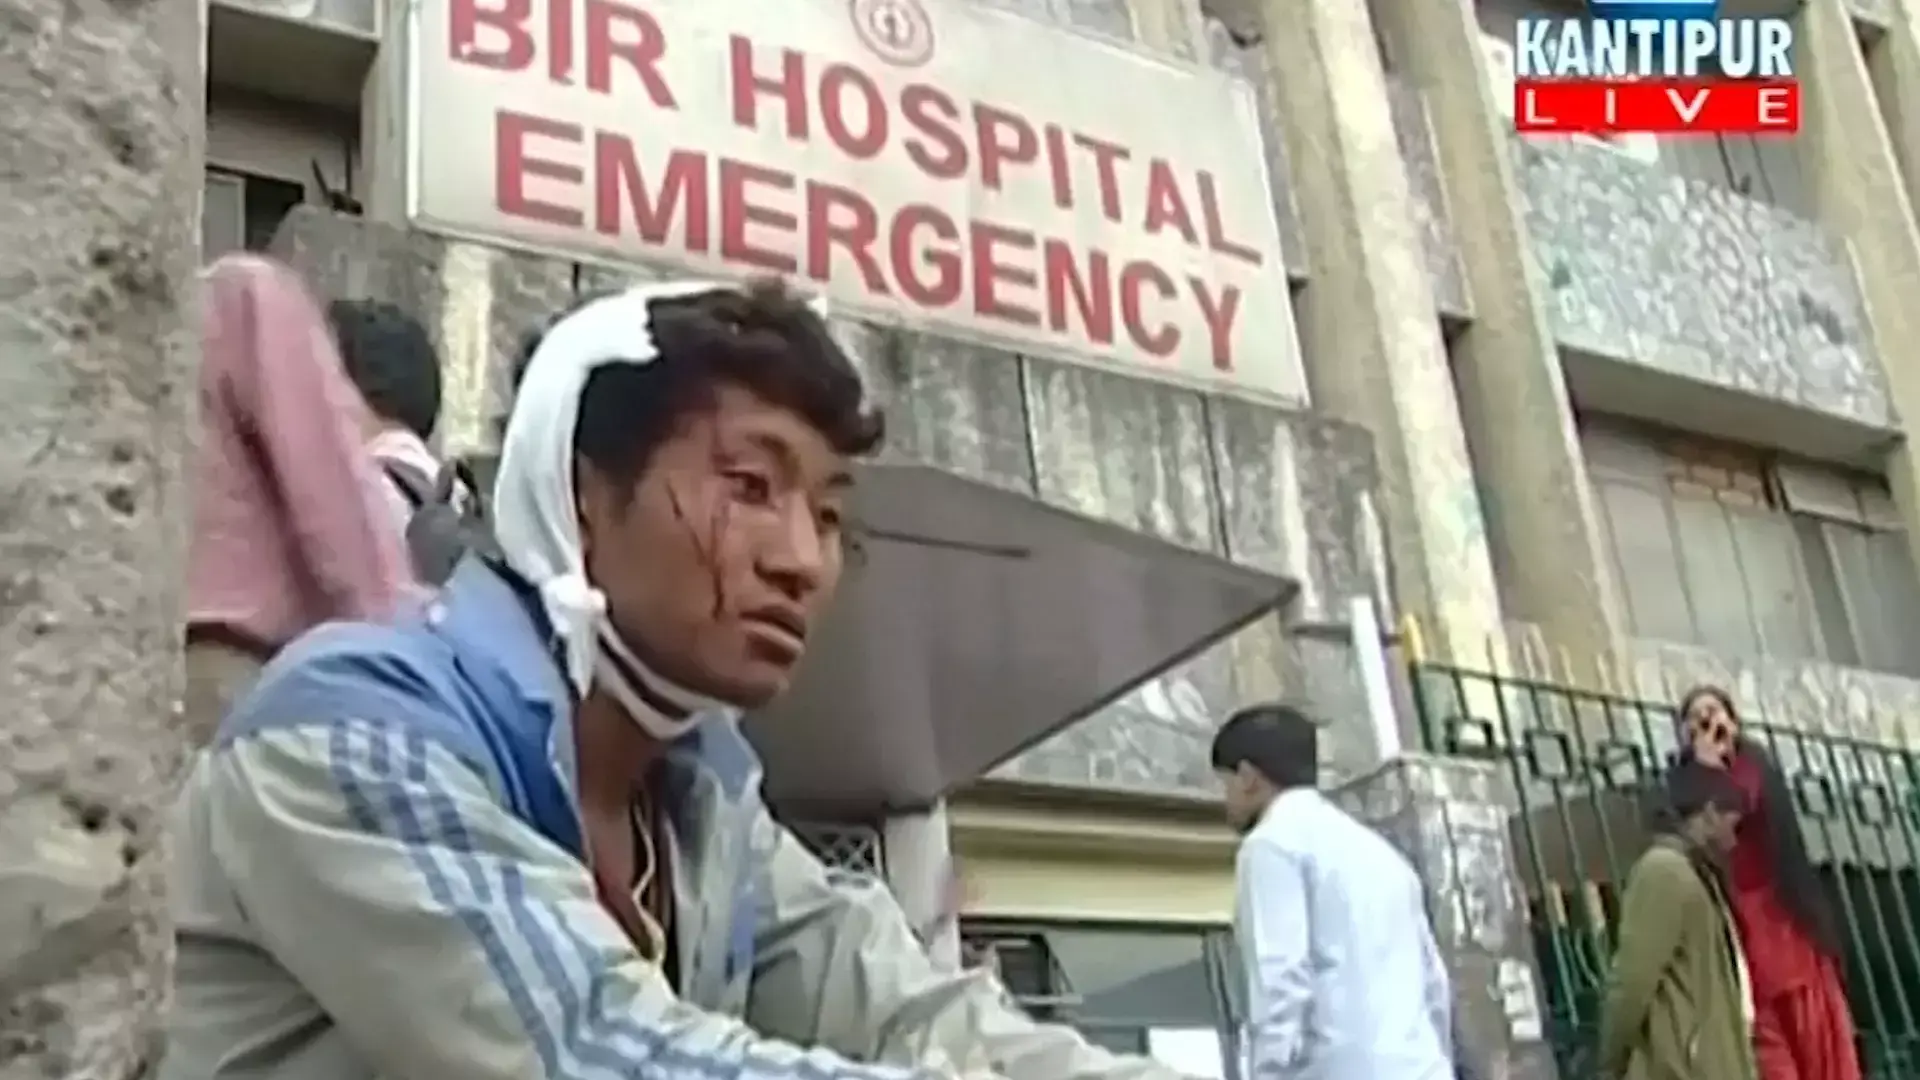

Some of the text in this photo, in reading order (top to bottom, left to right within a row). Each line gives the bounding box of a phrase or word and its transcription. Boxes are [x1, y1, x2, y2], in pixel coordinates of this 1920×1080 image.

[447, 0, 1263, 268] BIR HOSPITAL
[494, 109, 1242, 374] EMERGENCY
